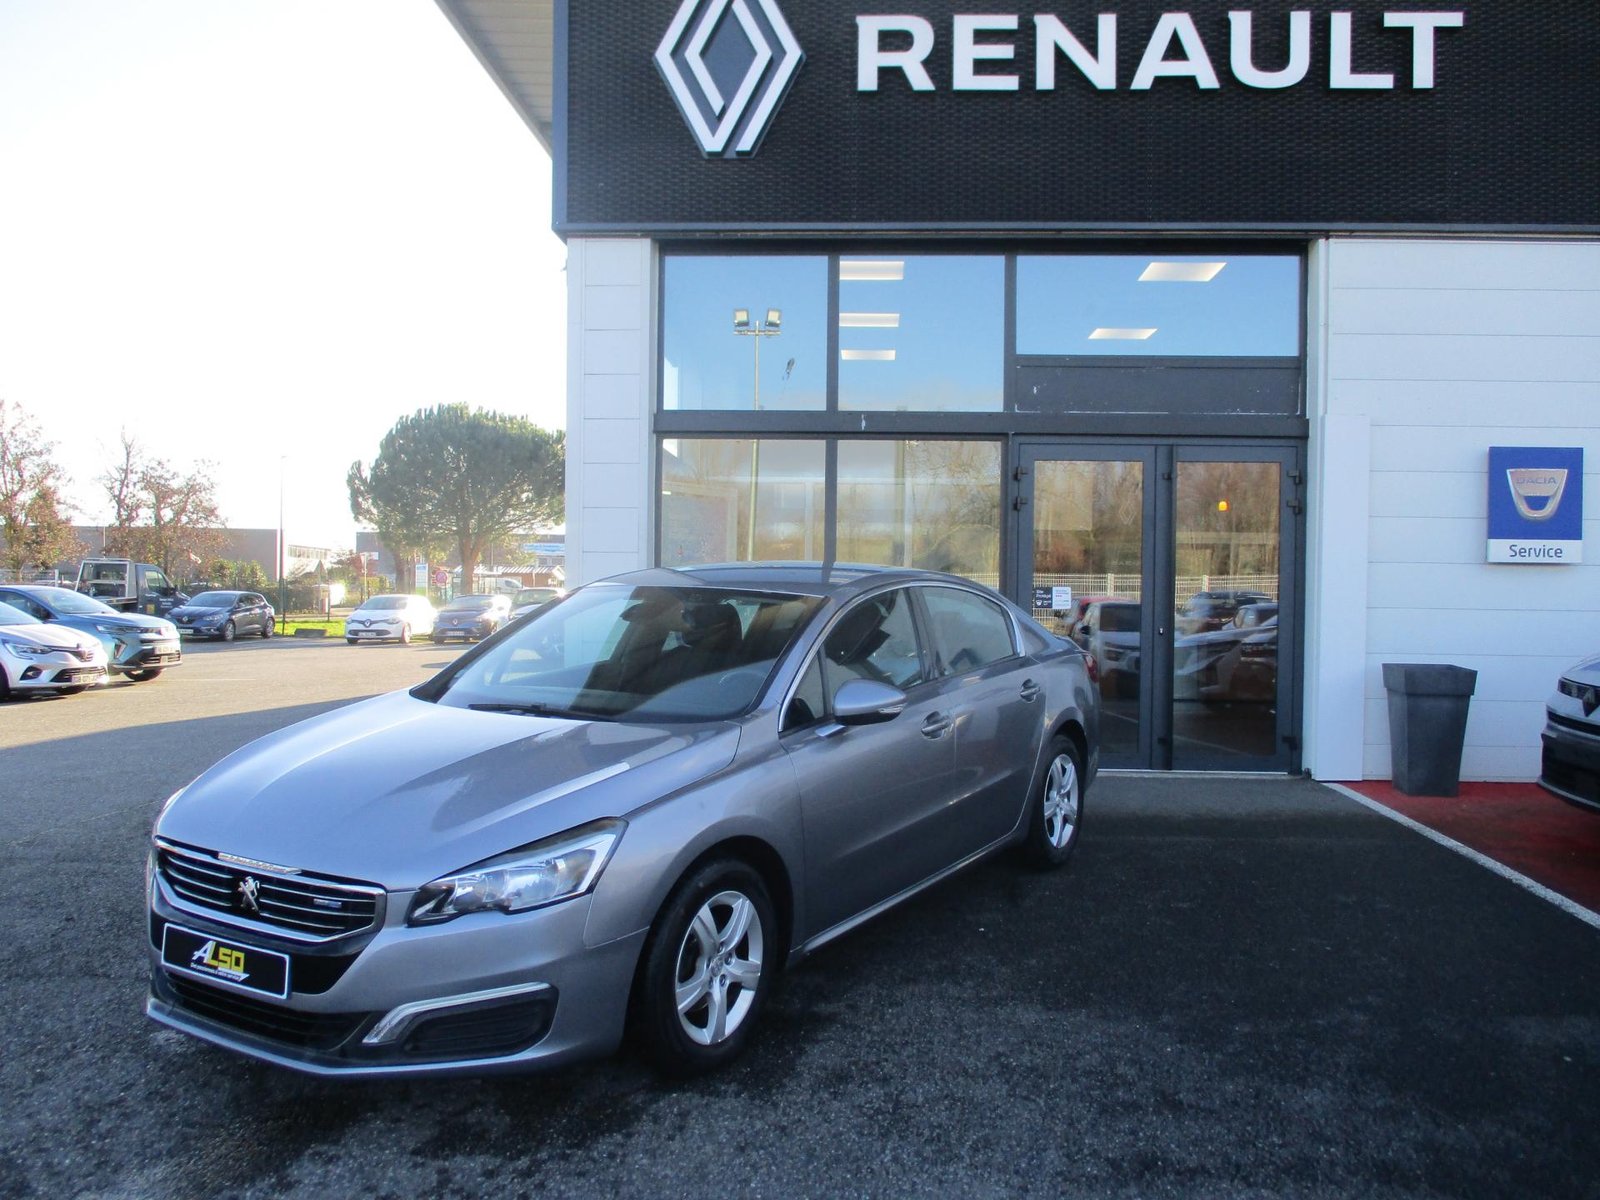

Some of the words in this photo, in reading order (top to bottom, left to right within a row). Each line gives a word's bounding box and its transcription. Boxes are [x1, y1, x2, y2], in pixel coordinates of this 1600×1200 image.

[855, 11, 1465, 93] RENAULT
[1515, 476, 1557, 485] DACIA
[1509, 544, 1563, 558] Service
[192, 940, 245, 973] ALSO
